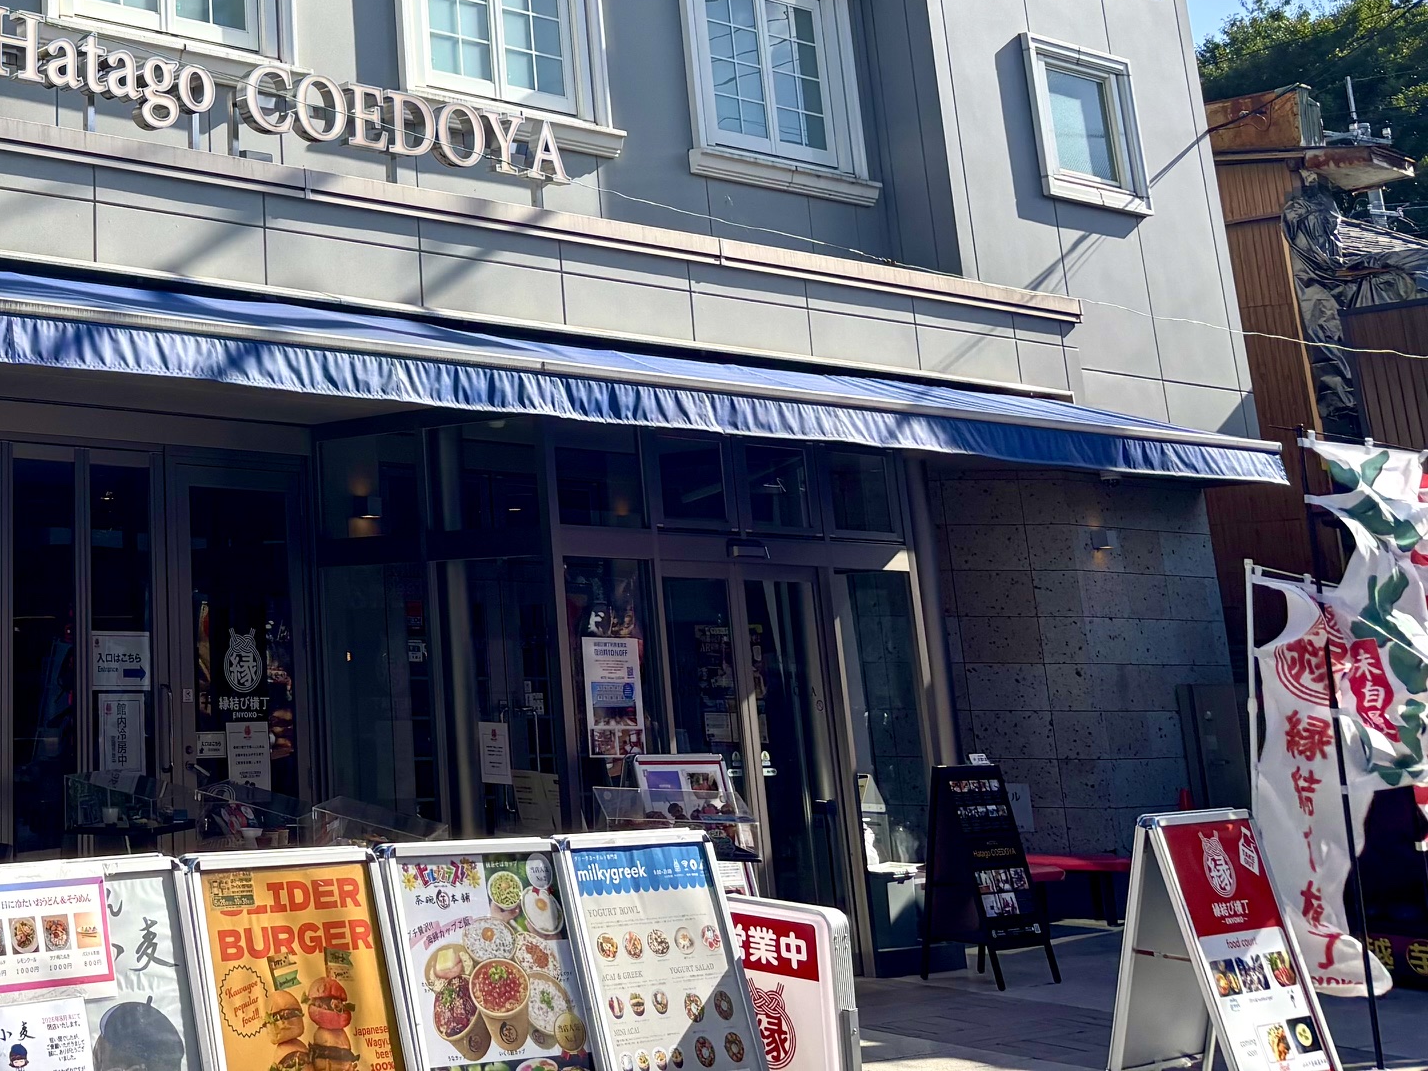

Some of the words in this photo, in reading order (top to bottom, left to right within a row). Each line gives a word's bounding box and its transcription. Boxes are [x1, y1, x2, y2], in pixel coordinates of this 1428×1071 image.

[236, 63, 570, 185] COEDOYA
[97, 652, 142, 664] 入口はこちら
[97, 665, 119, 673] Entrance
[218, 696, 270, 711] 縁結び横丁
[116, 702, 128, 767] 館内冷房中
[577, 860, 648, 885] milkygreek
[219, 877, 362, 917] IDER
[587, 907, 618, 917] YOGURT
[619, 905, 641, 915] BOWL
[1212, 899, 1249, 918] 縁結び横丁
[217, 918, 374, 963] BURGER
[1225, 938, 1241, 949] food
[1241, 936, 1258, 947] court
[16, 966, 40, 975] 1000円
[49, 962, 73, 971] 1000円
[669, 964, 694, 975] YOGURT
[695, 962, 715, 972] SALAD
[622, 970, 644, 979] GREEK
[224, 979, 259, 1000] Kawagoe
[233, 996, 260, 1017] popular
[352, 1025, 389, 1038] Japanese
